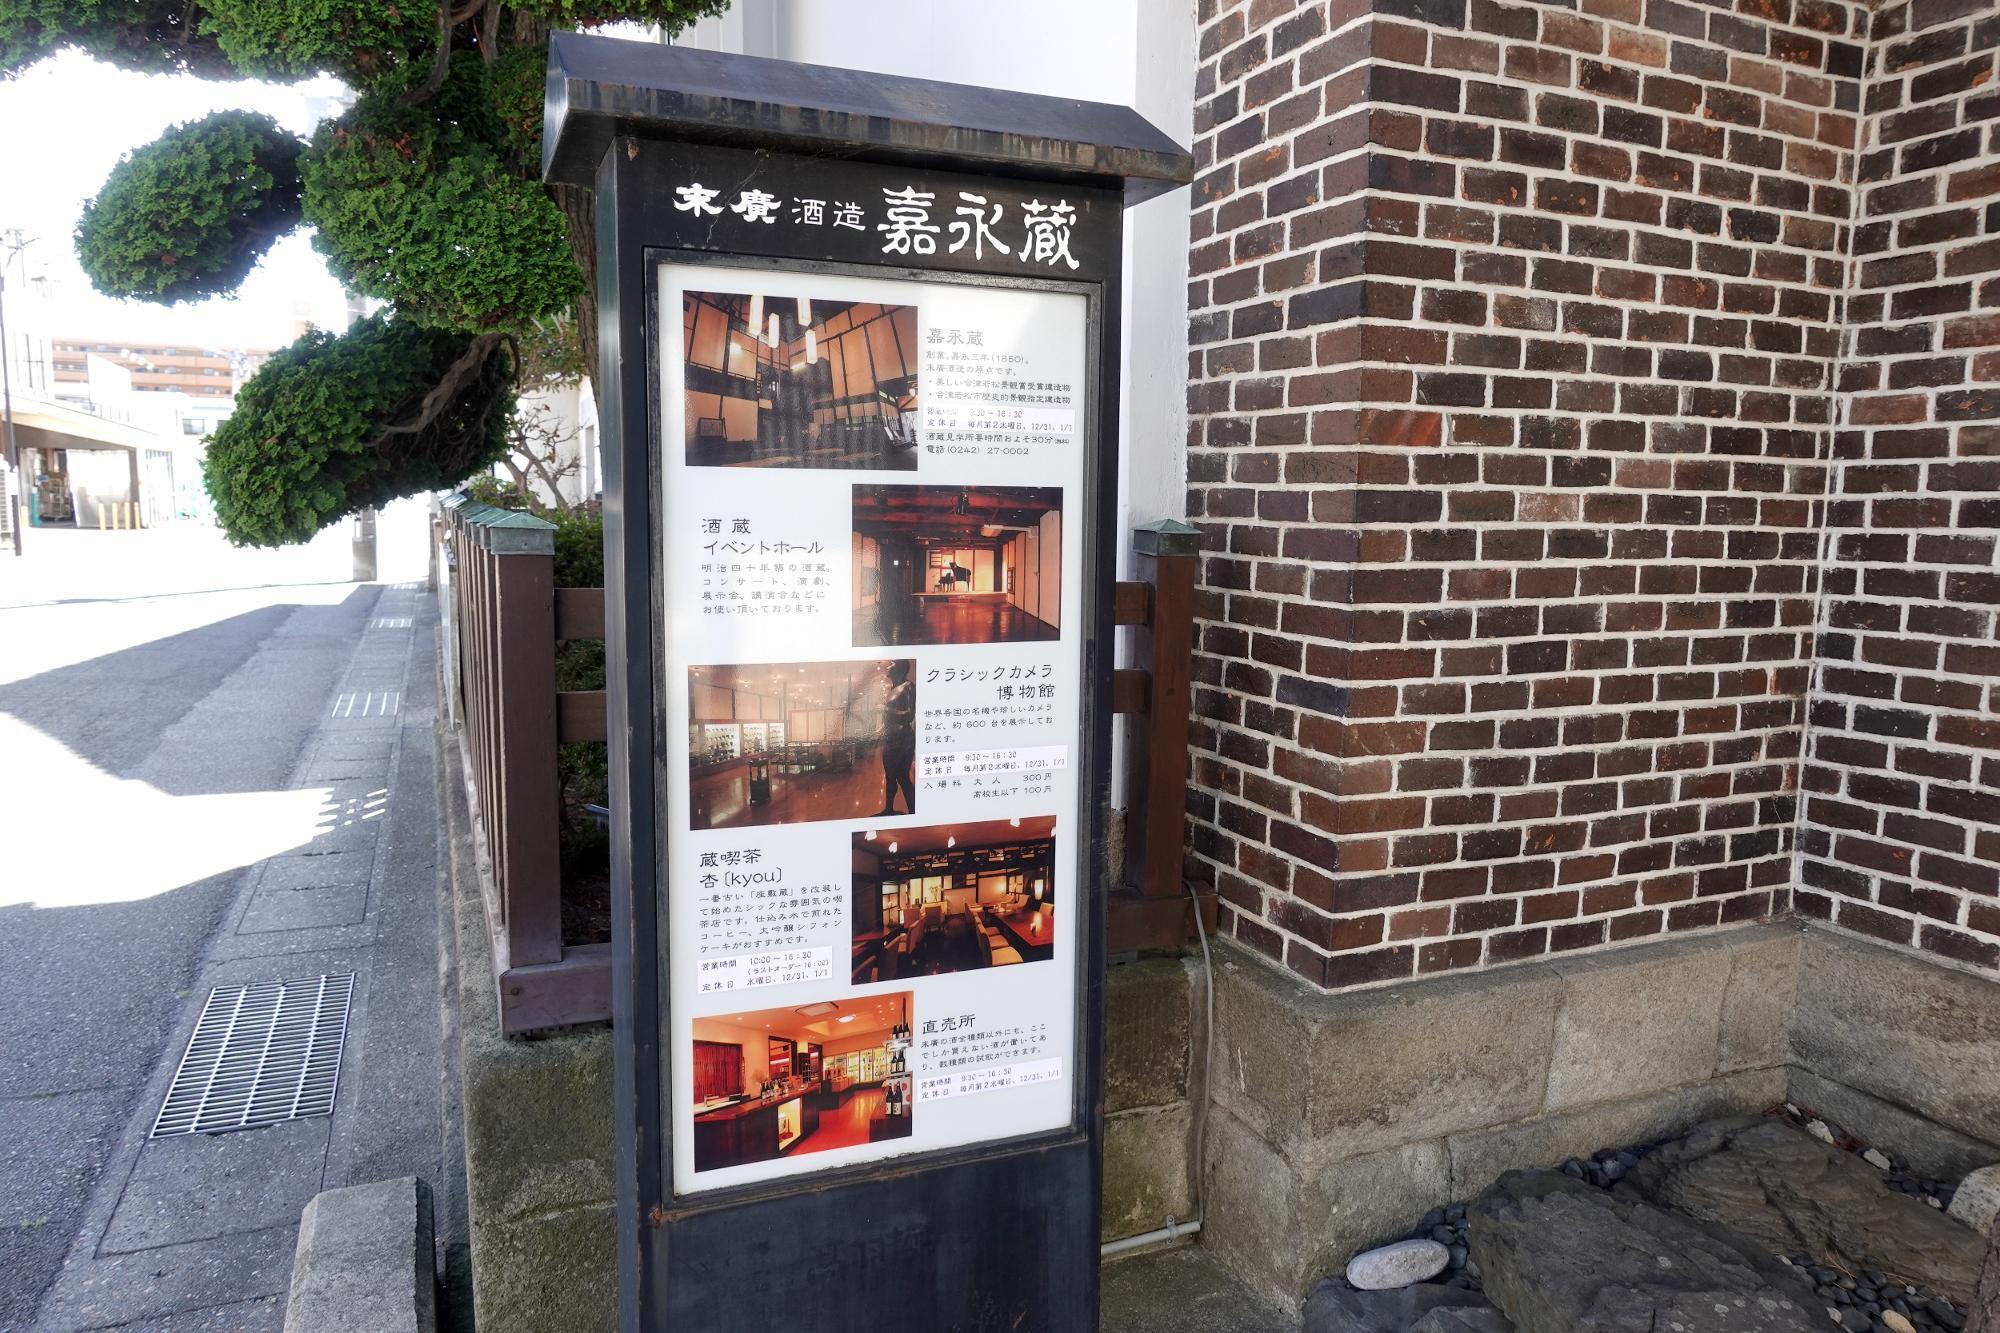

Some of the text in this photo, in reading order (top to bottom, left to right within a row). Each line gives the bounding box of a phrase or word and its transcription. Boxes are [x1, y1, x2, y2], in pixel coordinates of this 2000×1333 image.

[877, 185, 1080, 271] 嘉永蔵
[926, 327, 984, 346] 嘉永蔵
[987, 446, 1030, 456] 27-0002
[701, 518, 751, 534] 酒蔵
[703, 540, 825, 556] イベントホール
[927, 664, 1053, 683] クラシックカメラ
[996, 683, 1055, 701] 博物館
[923, 755, 956, 765] 営業時間
[924, 766, 952, 776] 定休日
[924, 779, 962, 790] 入場料
[973, 787, 1019, 799] 高校生以下
[699, 848, 762, 868] 蔵喫茶
[701, 959, 737, 972] 営業時間
[702, 980, 734, 992] 定休日
[922, 1013, 976, 1035] 直売所
